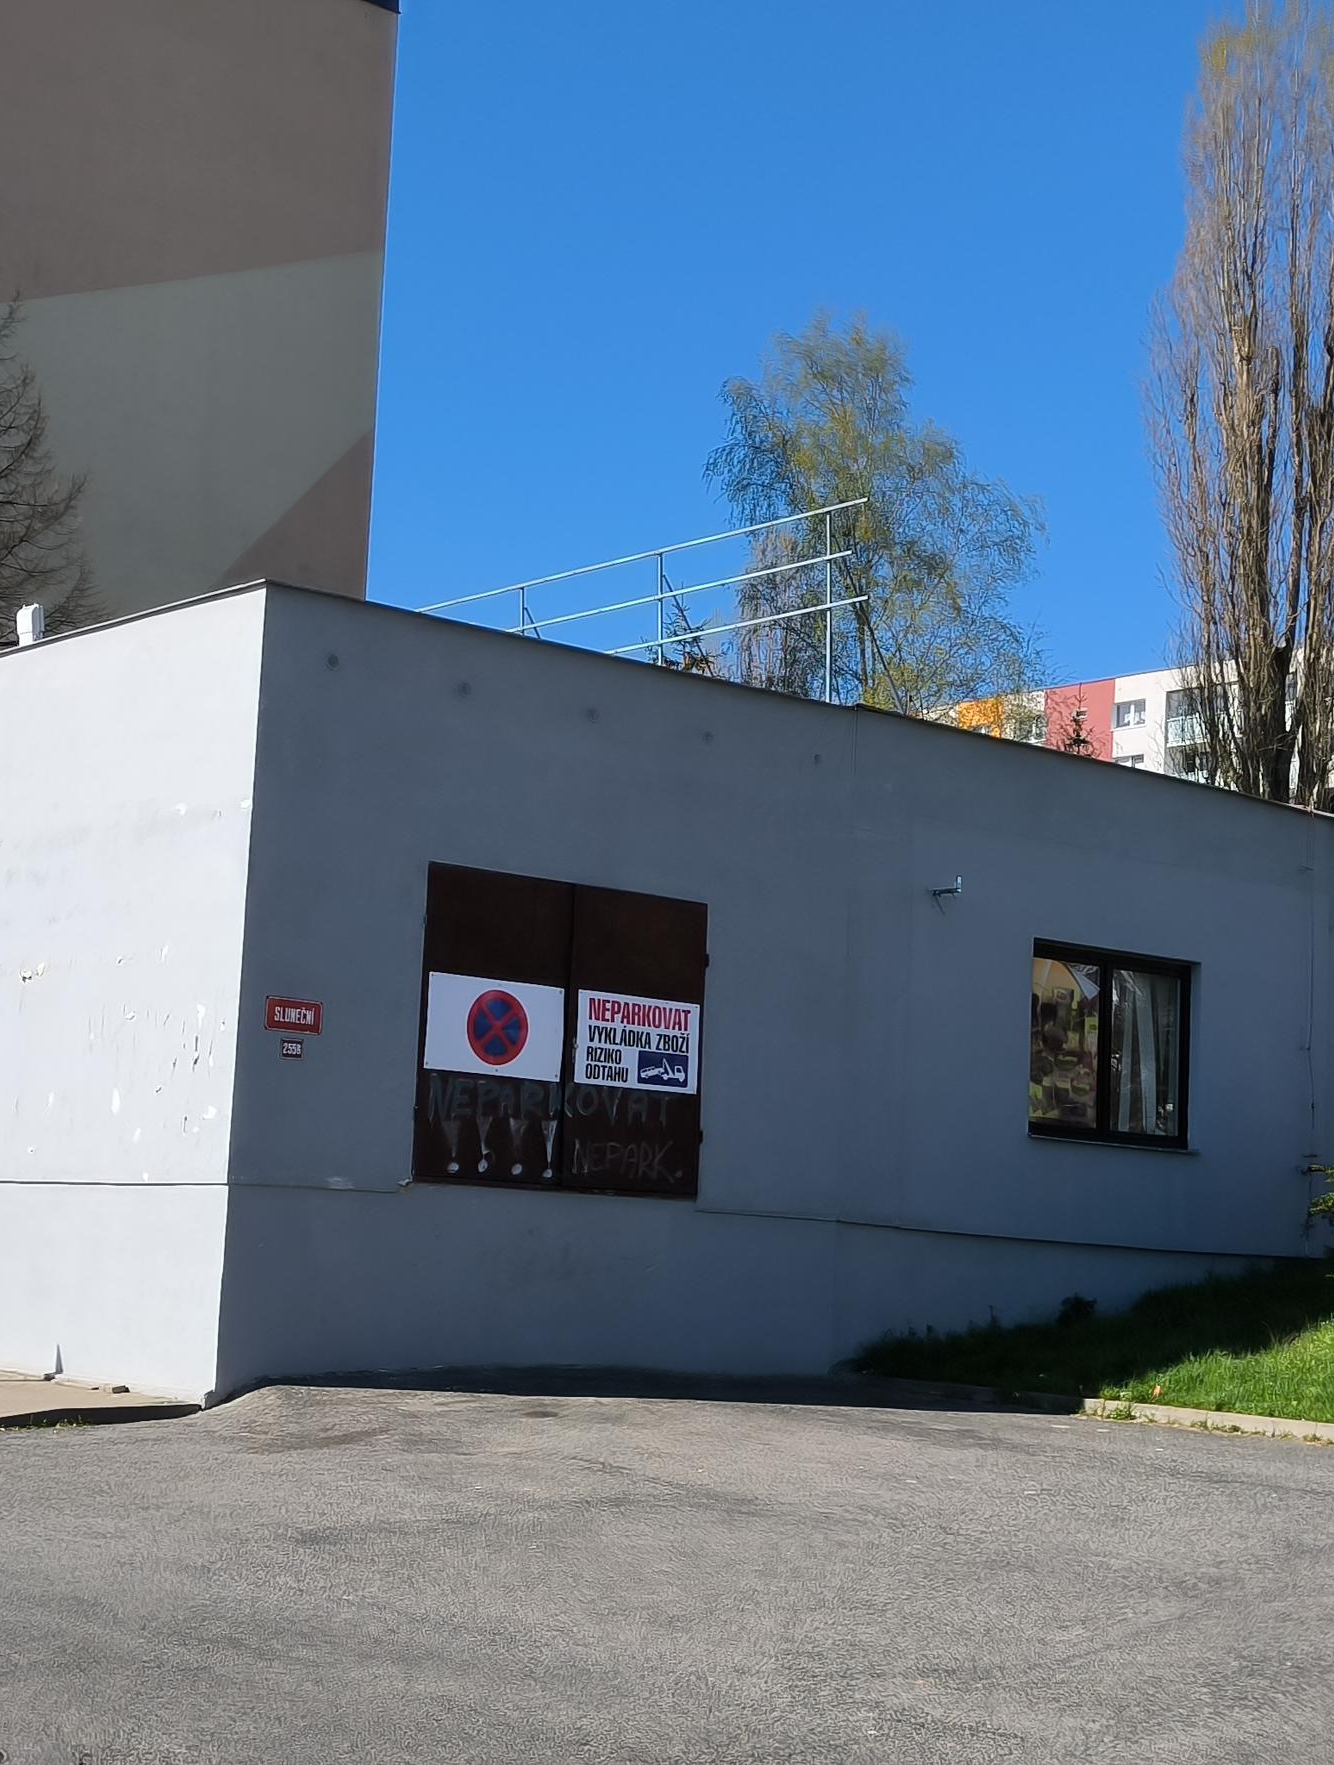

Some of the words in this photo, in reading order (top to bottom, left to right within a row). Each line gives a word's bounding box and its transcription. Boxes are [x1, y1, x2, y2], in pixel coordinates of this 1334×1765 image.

[274, 1006, 315, 1025] SLUNEČNÍ
[588, 997, 691, 1031] NEPARKOVAT
[588, 1025, 652, 1050] VYKLÁDKA
[655, 1033, 690, 1054] ZBOŽÍ
[586, 1046, 622, 1065] RIZIKO
[585, 1063, 629, 1083] ODTAHU
